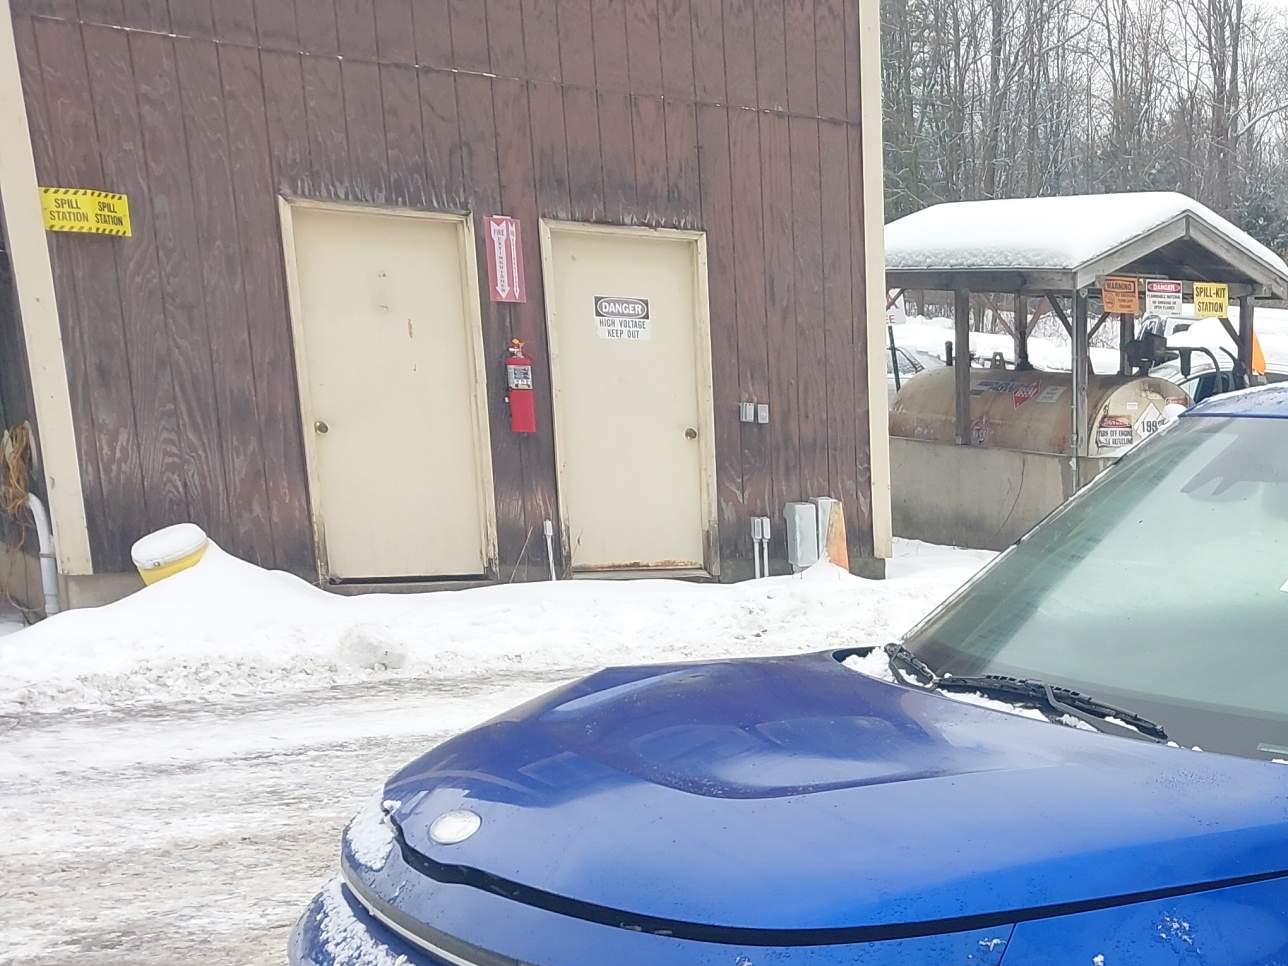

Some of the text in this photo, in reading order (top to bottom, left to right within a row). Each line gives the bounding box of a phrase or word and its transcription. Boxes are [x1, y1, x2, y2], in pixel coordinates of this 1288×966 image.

[54, 198, 81, 209] SPILL
[97, 201, 117, 213] SPILL
[49, 210, 89, 222] STATION
[95, 213, 123, 226] STATION
[1152, 283, 1176, 291] DANGER
[1195, 286, 1226, 298] SPILL-KIT
[602, 302, 642, 314] DANGER
[1197, 301, 1224, 312] STATION
[599, 319, 646, 329] HIGH VOLTAGE
[607, 329, 640, 338] KEEP OUT
